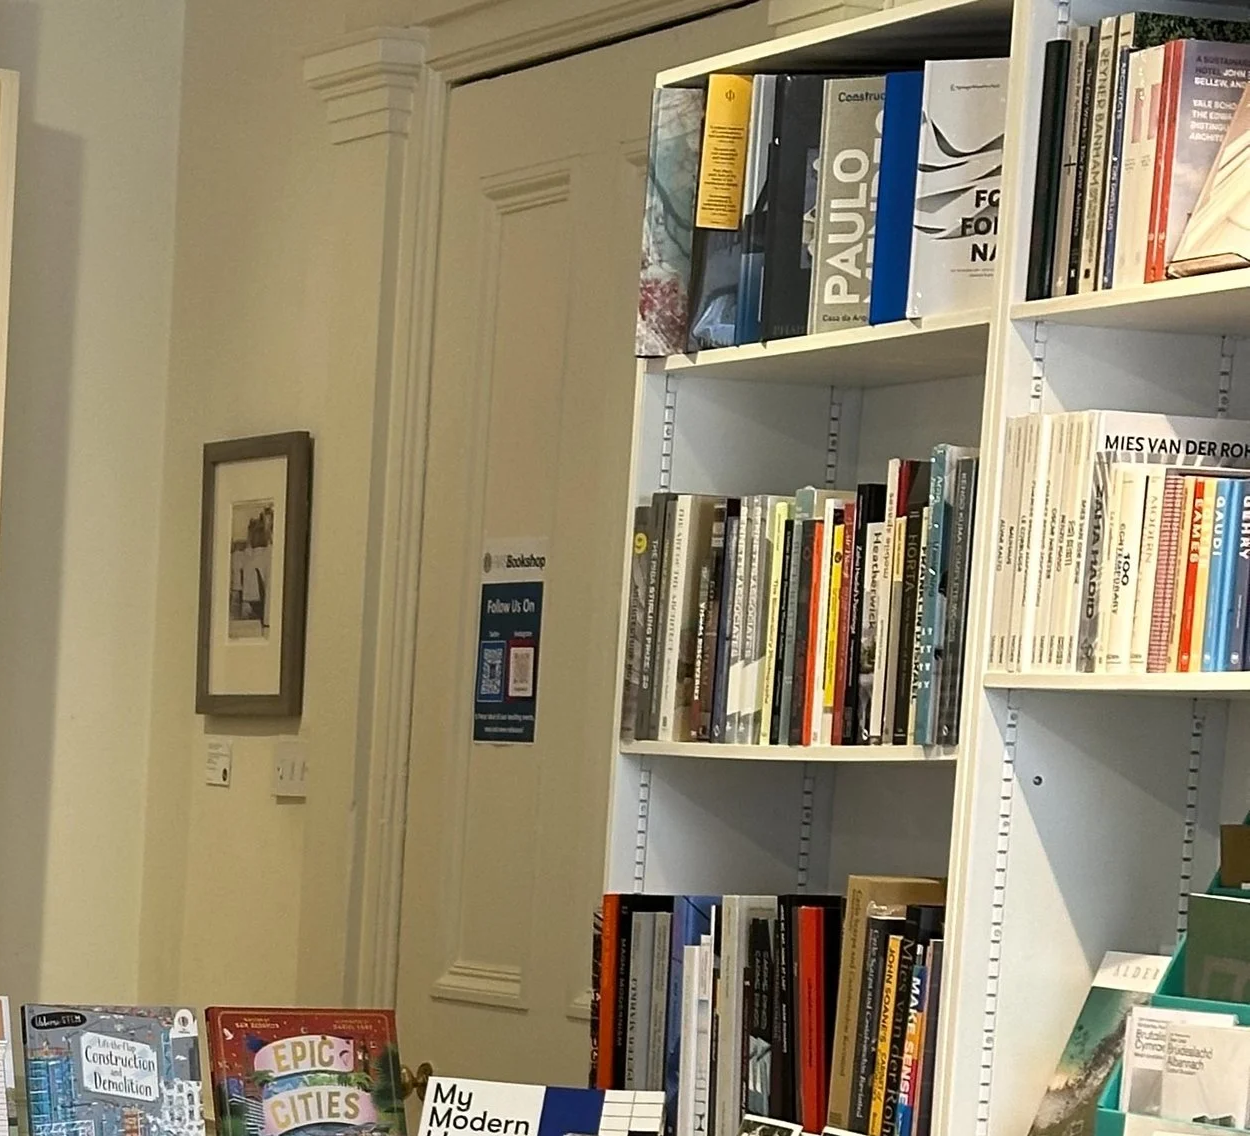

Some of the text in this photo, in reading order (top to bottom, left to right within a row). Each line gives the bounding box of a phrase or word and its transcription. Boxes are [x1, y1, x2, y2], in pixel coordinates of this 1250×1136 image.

[837, 90, 885, 102] Construc
[1090, 47, 1111, 186] REYNER BANHAM
[822, 148, 870, 306] PAULO
[1104, 435, 1145, 452] MIES
[1148, 437, 1181, 455] VAN
[1185, 440, 1218, 457] DER
[958, 472, 967, 510] KENGO
[956, 512, 965, 543] KUMA
[1189, 497, 1203, 564] EAMES
[904, 533, 918, 593] HORTA
[1085, 485, 1104, 620] ZAHA HADID
[1121, 552, 1131, 587] 100
[867, 531, 882, 630] Heatherwick
[487, 598, 536, 614] Follow Us On
[692, 601, 707, 701] VISUAL DISCOVERIES
[865, 958, 877, 988] Scarpa
[897, 938, 915, 992] Mies
[865, 990, 873, 1009] and
[893, 1001, 904, 1038] van
[85, 1045, 156, 1072] Construction
[272, 1040, 336, 1073] EPIC
[898, 976, 922, 1107] MAKE SENSE
[110, 1067, 122, 1077] and
[887, 1045, 903, 1083] der
[93, 1071, 152, 1096] Demolition
[432, 1082, 473, 1112] My
[855, 1075, 867, 1119] Revisited
[272, 1090, 361, 1131] CITIES
[428, 1106, 530, 1136] Modern
